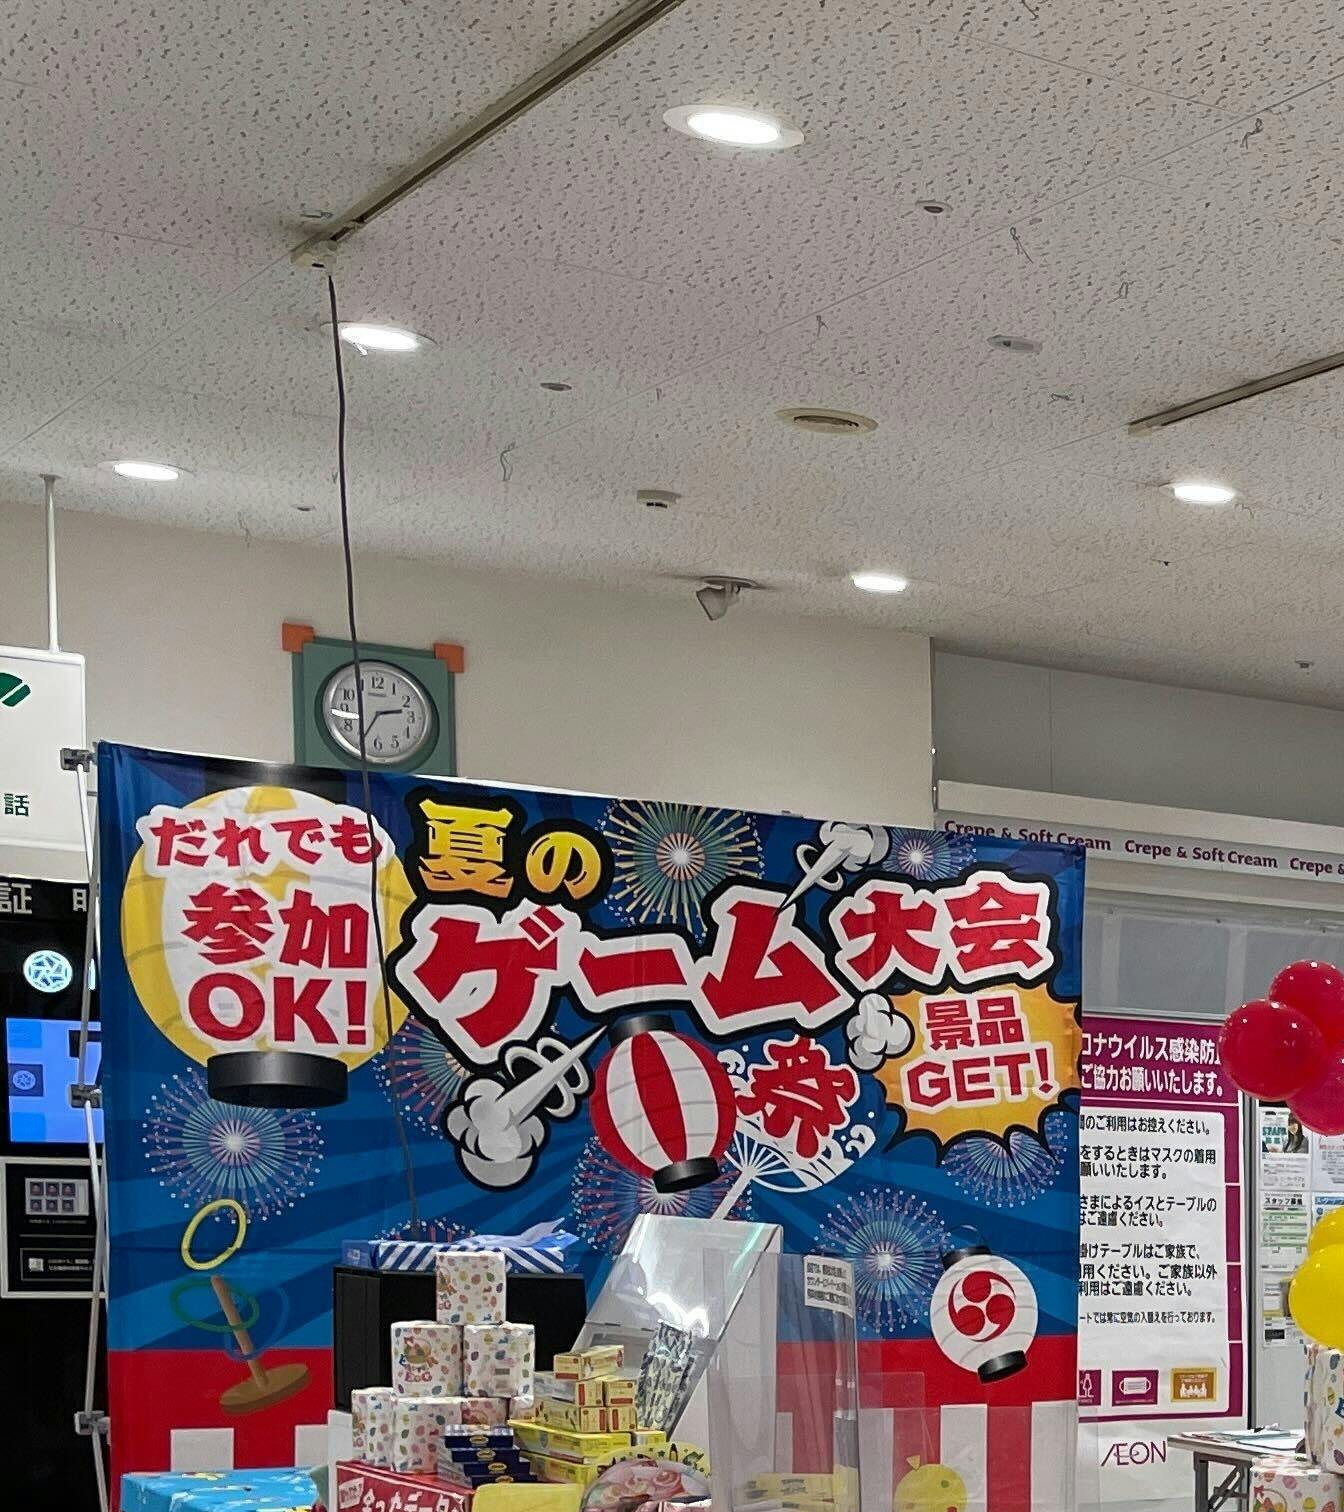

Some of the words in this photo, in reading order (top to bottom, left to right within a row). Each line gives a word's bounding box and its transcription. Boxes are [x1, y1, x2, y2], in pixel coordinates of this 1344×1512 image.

[3, 792, 30, 817] 話
[148, 813, 384, 870] だれでも
[419, 798, 602, 900] 夏の
[1124, 838, 1172, 859] Crepe
[1176, 845, 1188, 859] &
[1192, 846, 1225, 863] Soft
[1227, 850, 1278, 869] Cream
[1289, 857, 1333, 876] Crepe
[181, 880, 370, 970] 参加
[187, 972, 368, 1046] OK!
[925, 996, 1023, 1051] 景品
[906, 1050, 1056, 1108] GET!
[1081, 1063, 1223, 1097] ご協力お願いいたします。
[1079, 1263, 1218, 1280] 用ください。ご家族以外
